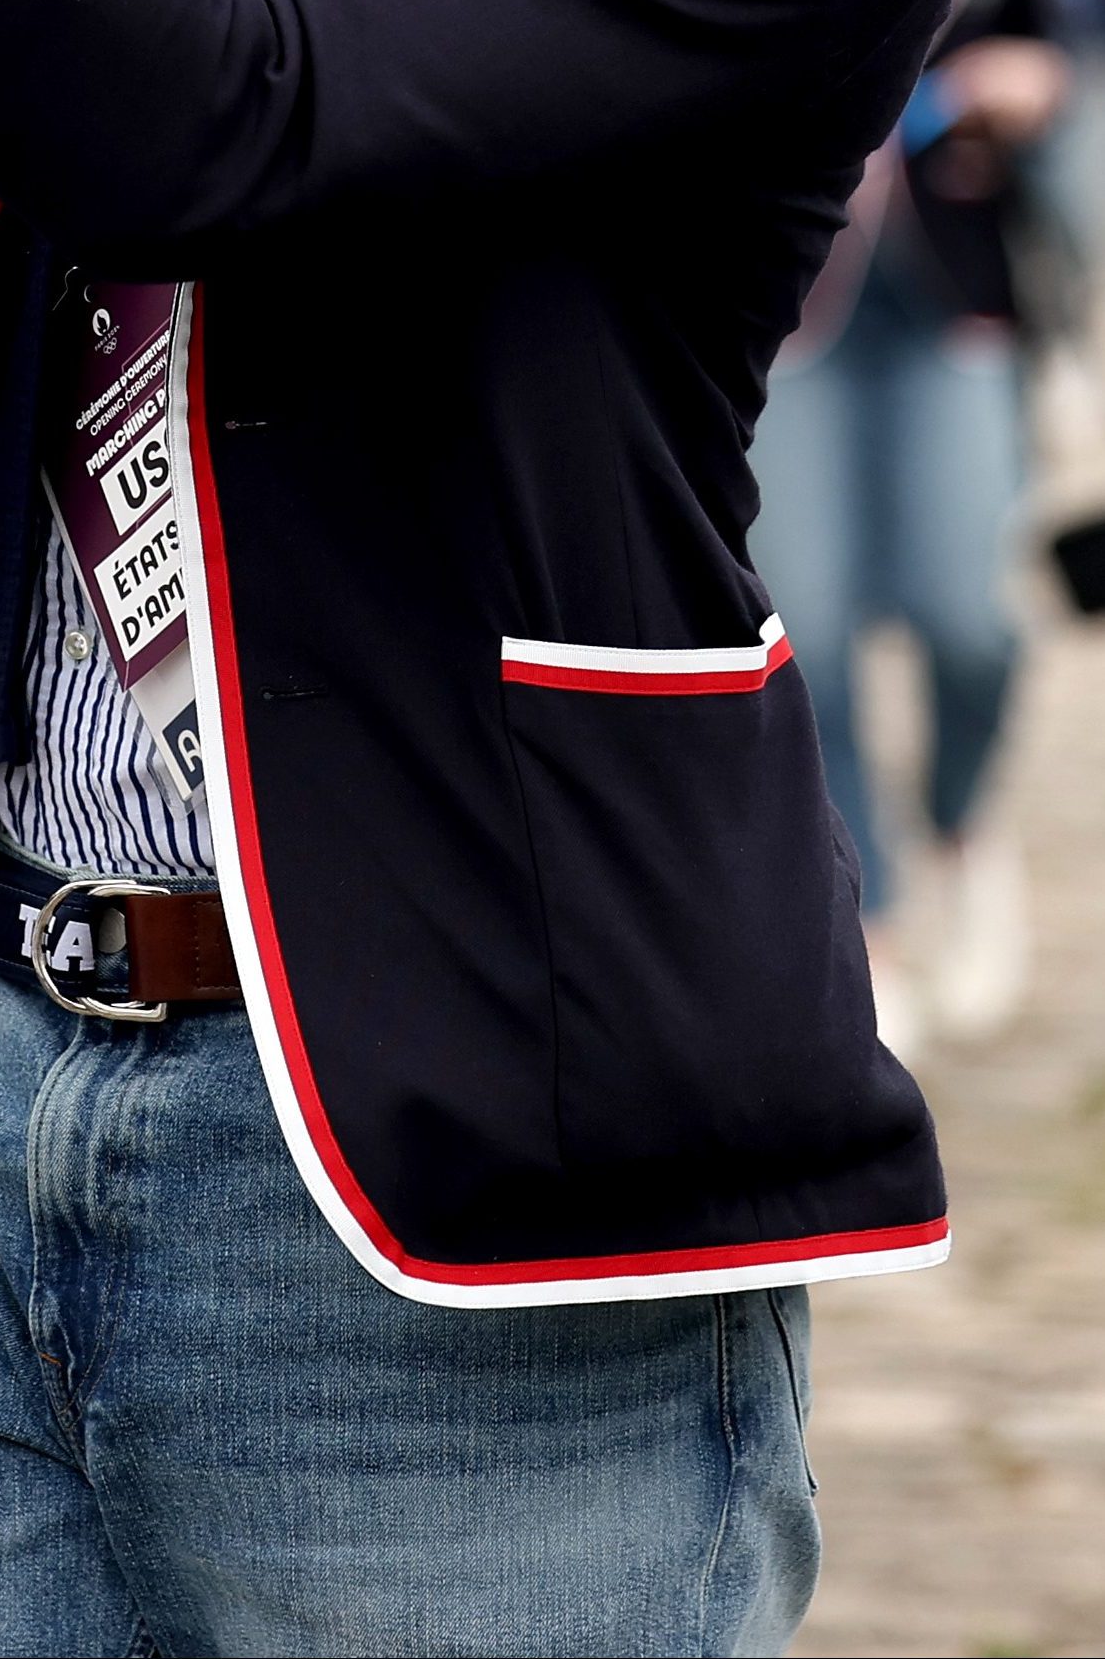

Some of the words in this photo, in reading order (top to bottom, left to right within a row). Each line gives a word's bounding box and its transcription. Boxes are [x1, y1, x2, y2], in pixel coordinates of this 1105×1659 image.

[75, 384, 122, 430] CÉRÉMONIE
[85, 399, 158, 477] MARCHING
[90, 397, 126, 436] OPENING
[116, 427, 170, 510] US
